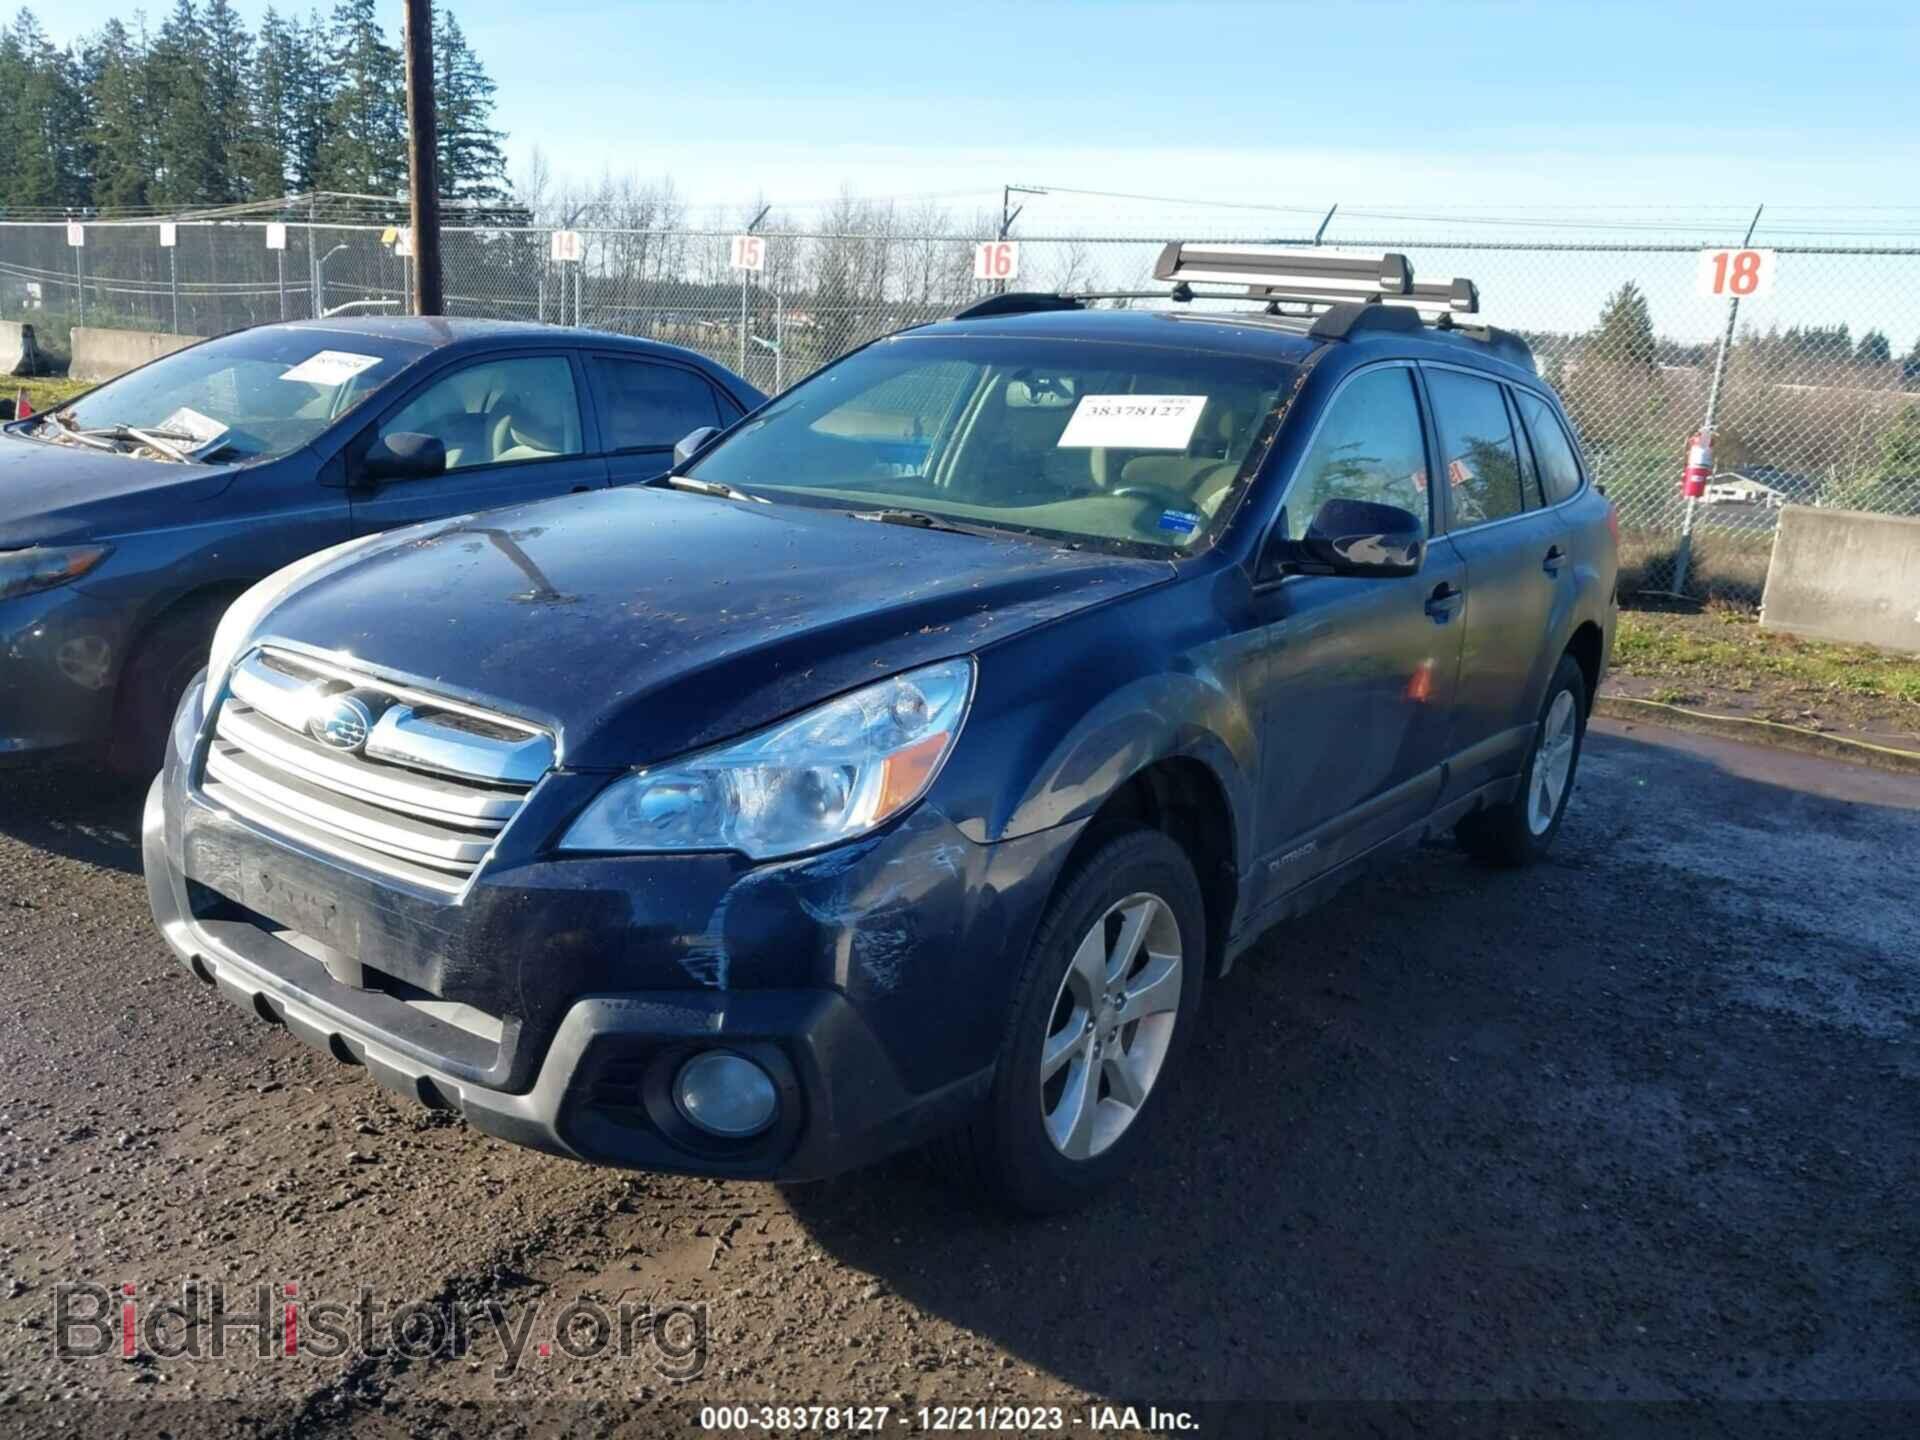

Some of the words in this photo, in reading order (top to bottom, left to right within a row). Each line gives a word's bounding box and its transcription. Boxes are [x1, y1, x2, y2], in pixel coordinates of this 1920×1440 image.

[738, 239, 760, 266] 15
[983, 244, 1011, 275] 16
[1712, 251, 1761, 295] 18
[1086, 405, 1185, 417] 38378127
